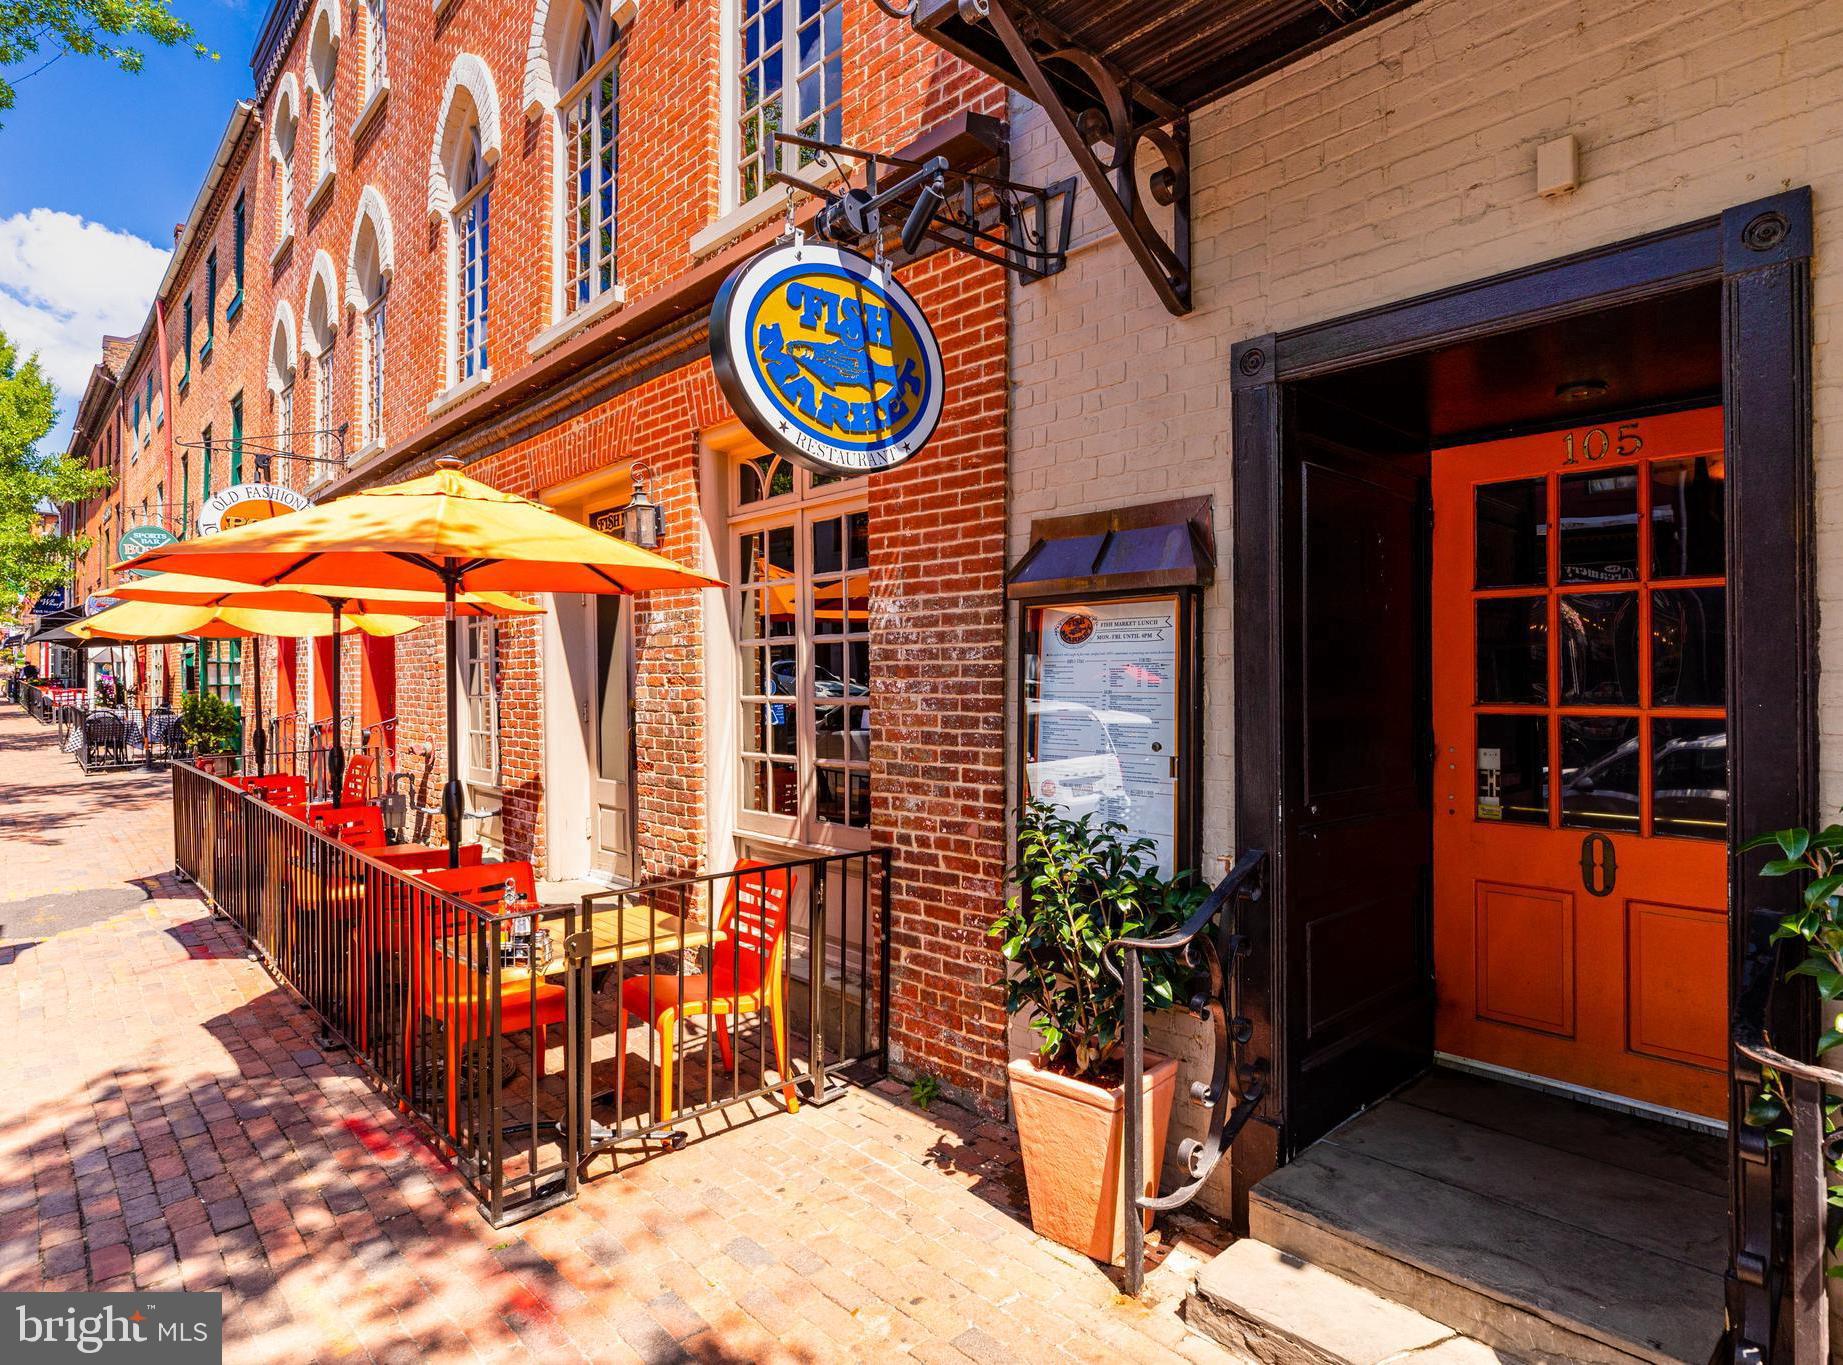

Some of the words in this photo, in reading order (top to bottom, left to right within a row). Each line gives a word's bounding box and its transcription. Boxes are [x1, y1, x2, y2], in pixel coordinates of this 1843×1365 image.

[786, 281, 892, 351] FISH
[759, 322, 921, 434] MARKET
[796, 431, 898, 468] RESTAURANT
[1562, 424, 1643, 465] 105
[212, 491, 240, 511] OLD
[597, 512, 620, 531] FISH
